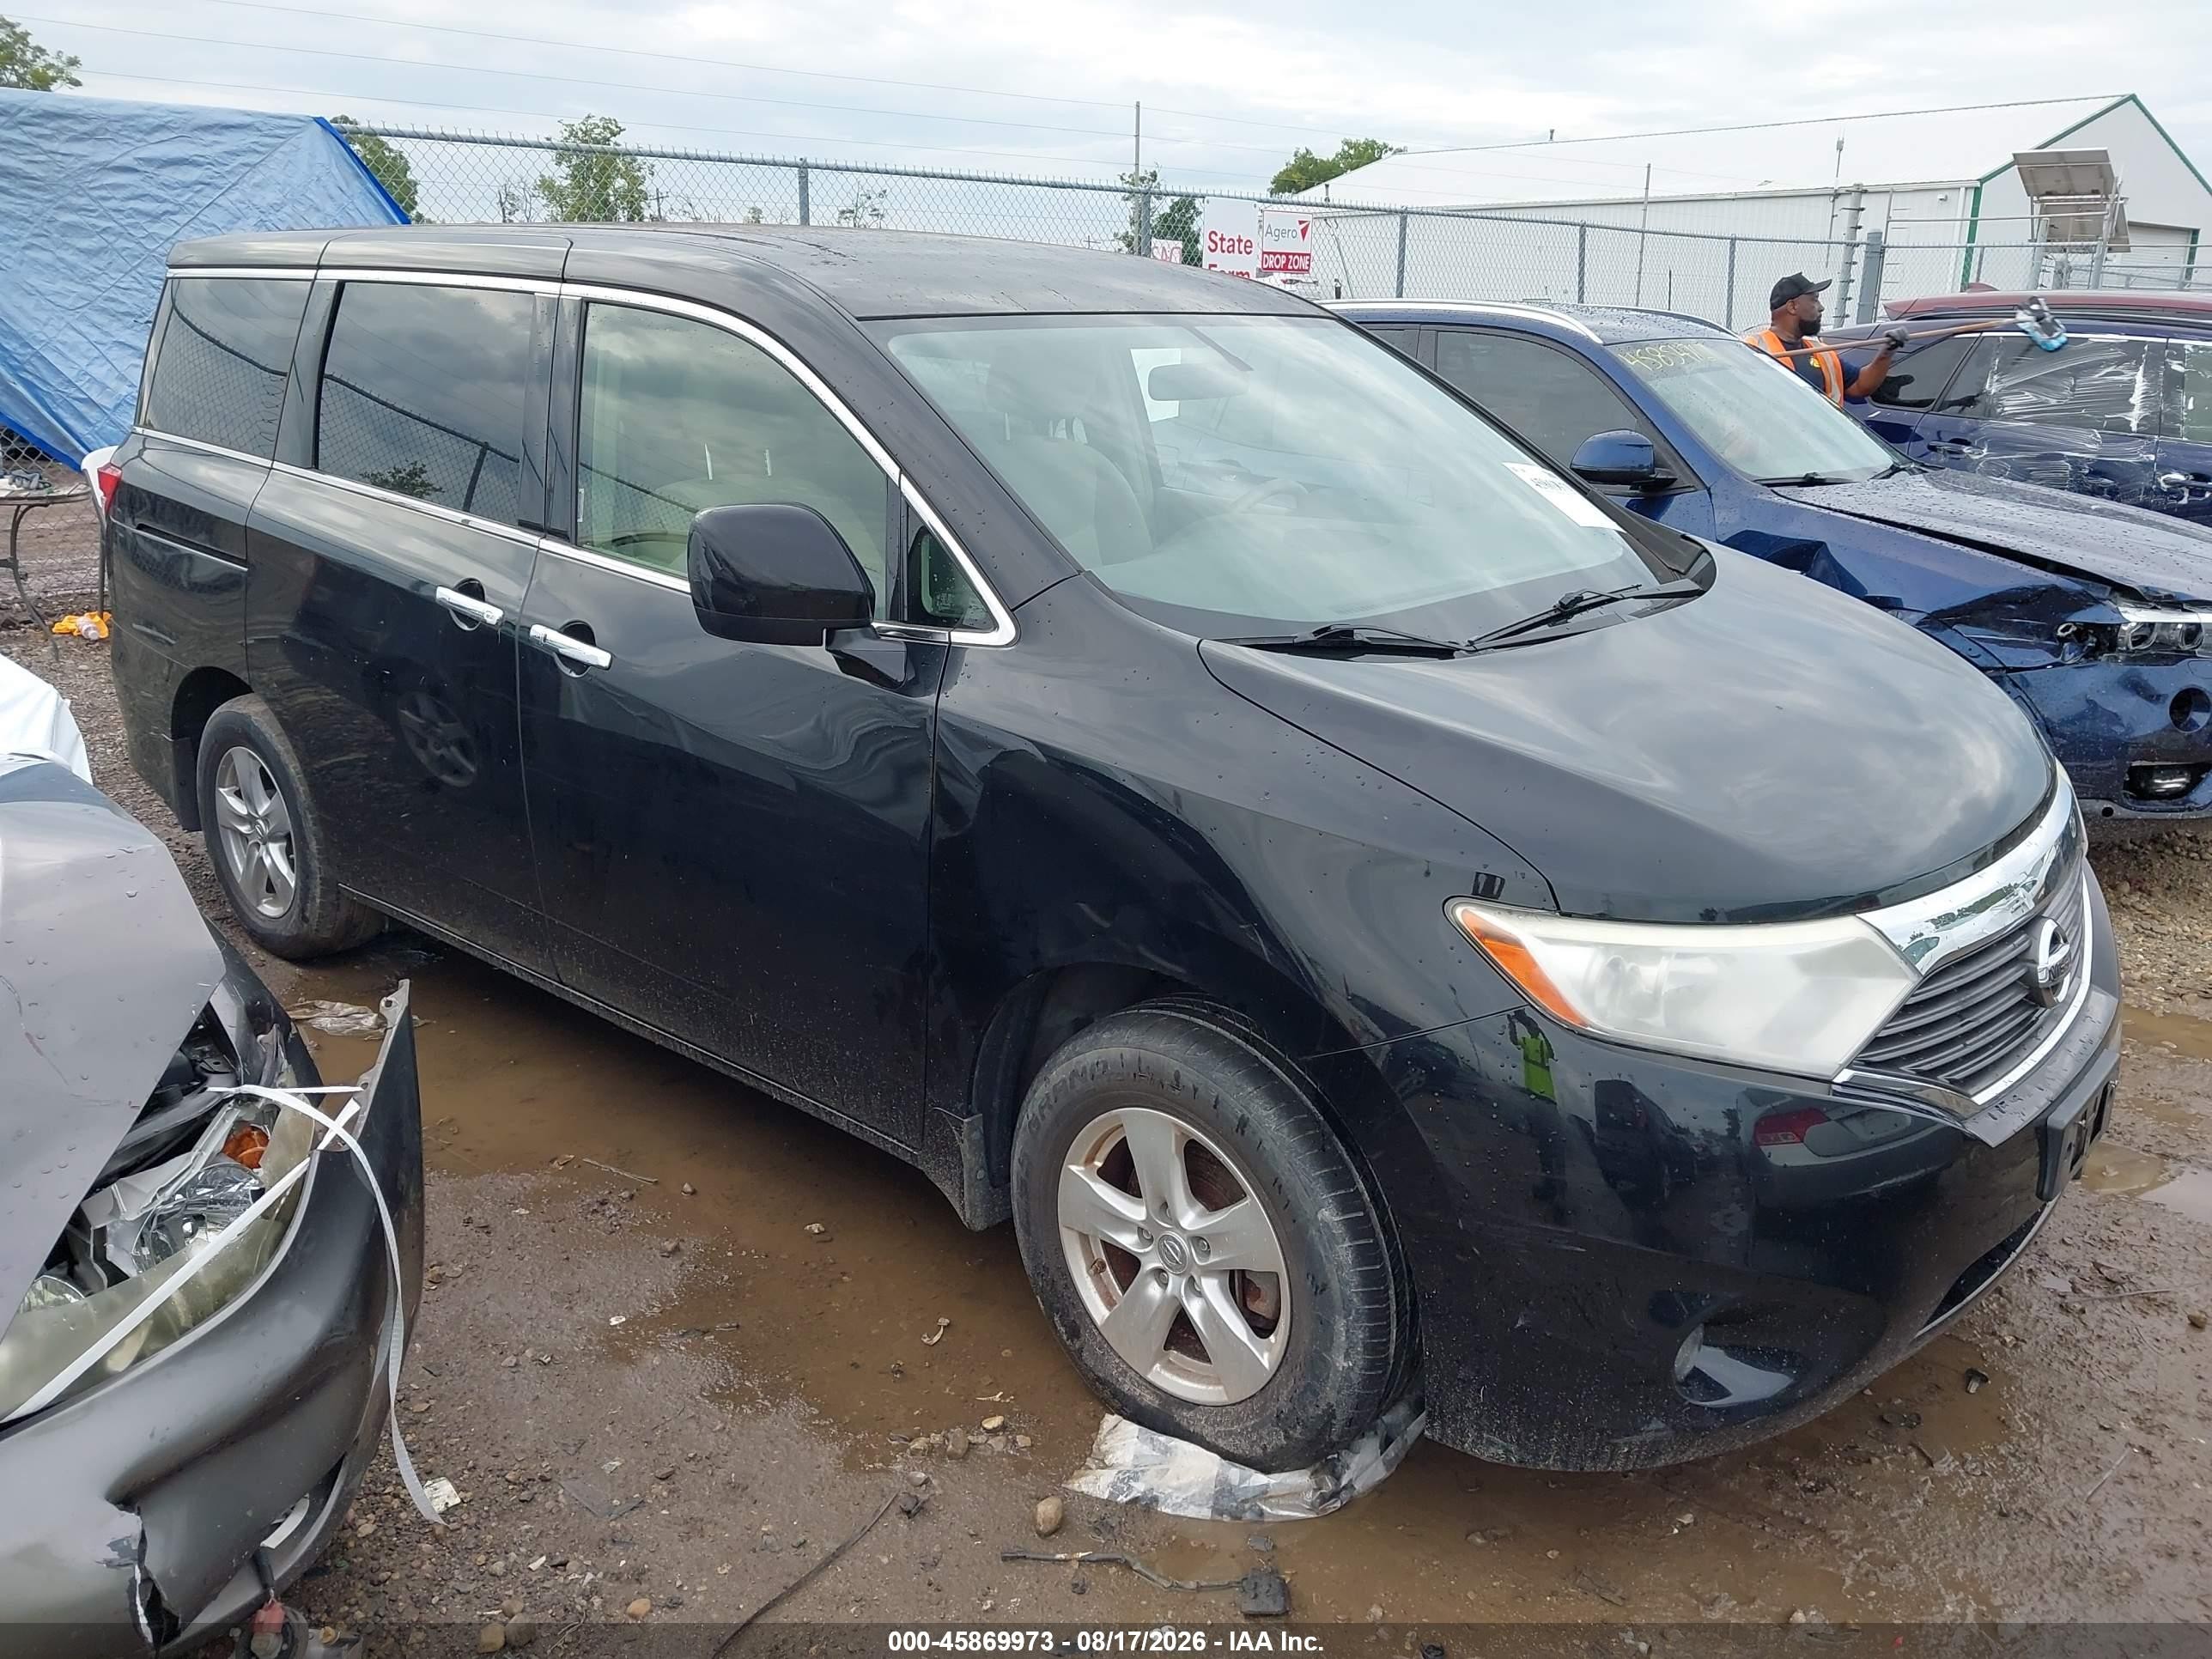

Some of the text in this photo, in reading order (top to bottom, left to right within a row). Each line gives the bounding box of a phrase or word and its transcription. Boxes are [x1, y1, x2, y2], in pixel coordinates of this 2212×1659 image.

[1265, 223, 1298, 242] Agero
[1207, 230, 1254, 255] State
[1262, 253, 1310, 270] DROP ZONE
